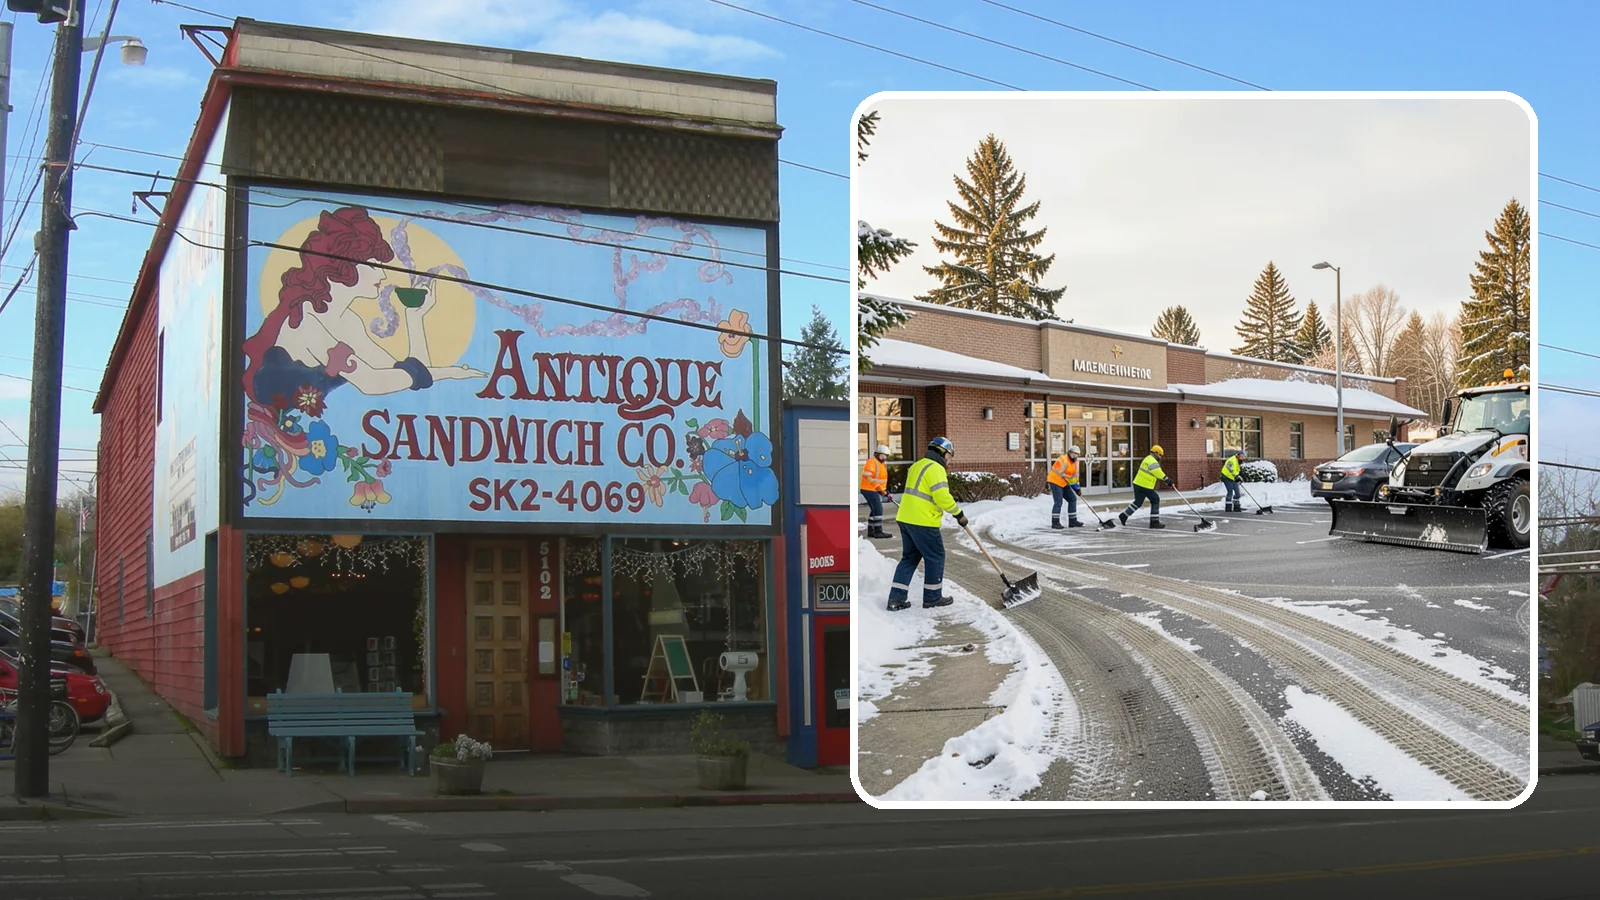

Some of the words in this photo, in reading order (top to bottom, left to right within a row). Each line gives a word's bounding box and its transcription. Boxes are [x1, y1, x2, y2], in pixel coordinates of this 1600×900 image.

[475, 328, 724, 421] ANTIQUE
[361, 408, 605, 468] SANDWICH
[617, 422, 685, 470] CO.
[468, 476, 647, 513] SK2-4069
[539, 541, 552, 600] 5102
[809, 555, 835, 569] BOOKS
